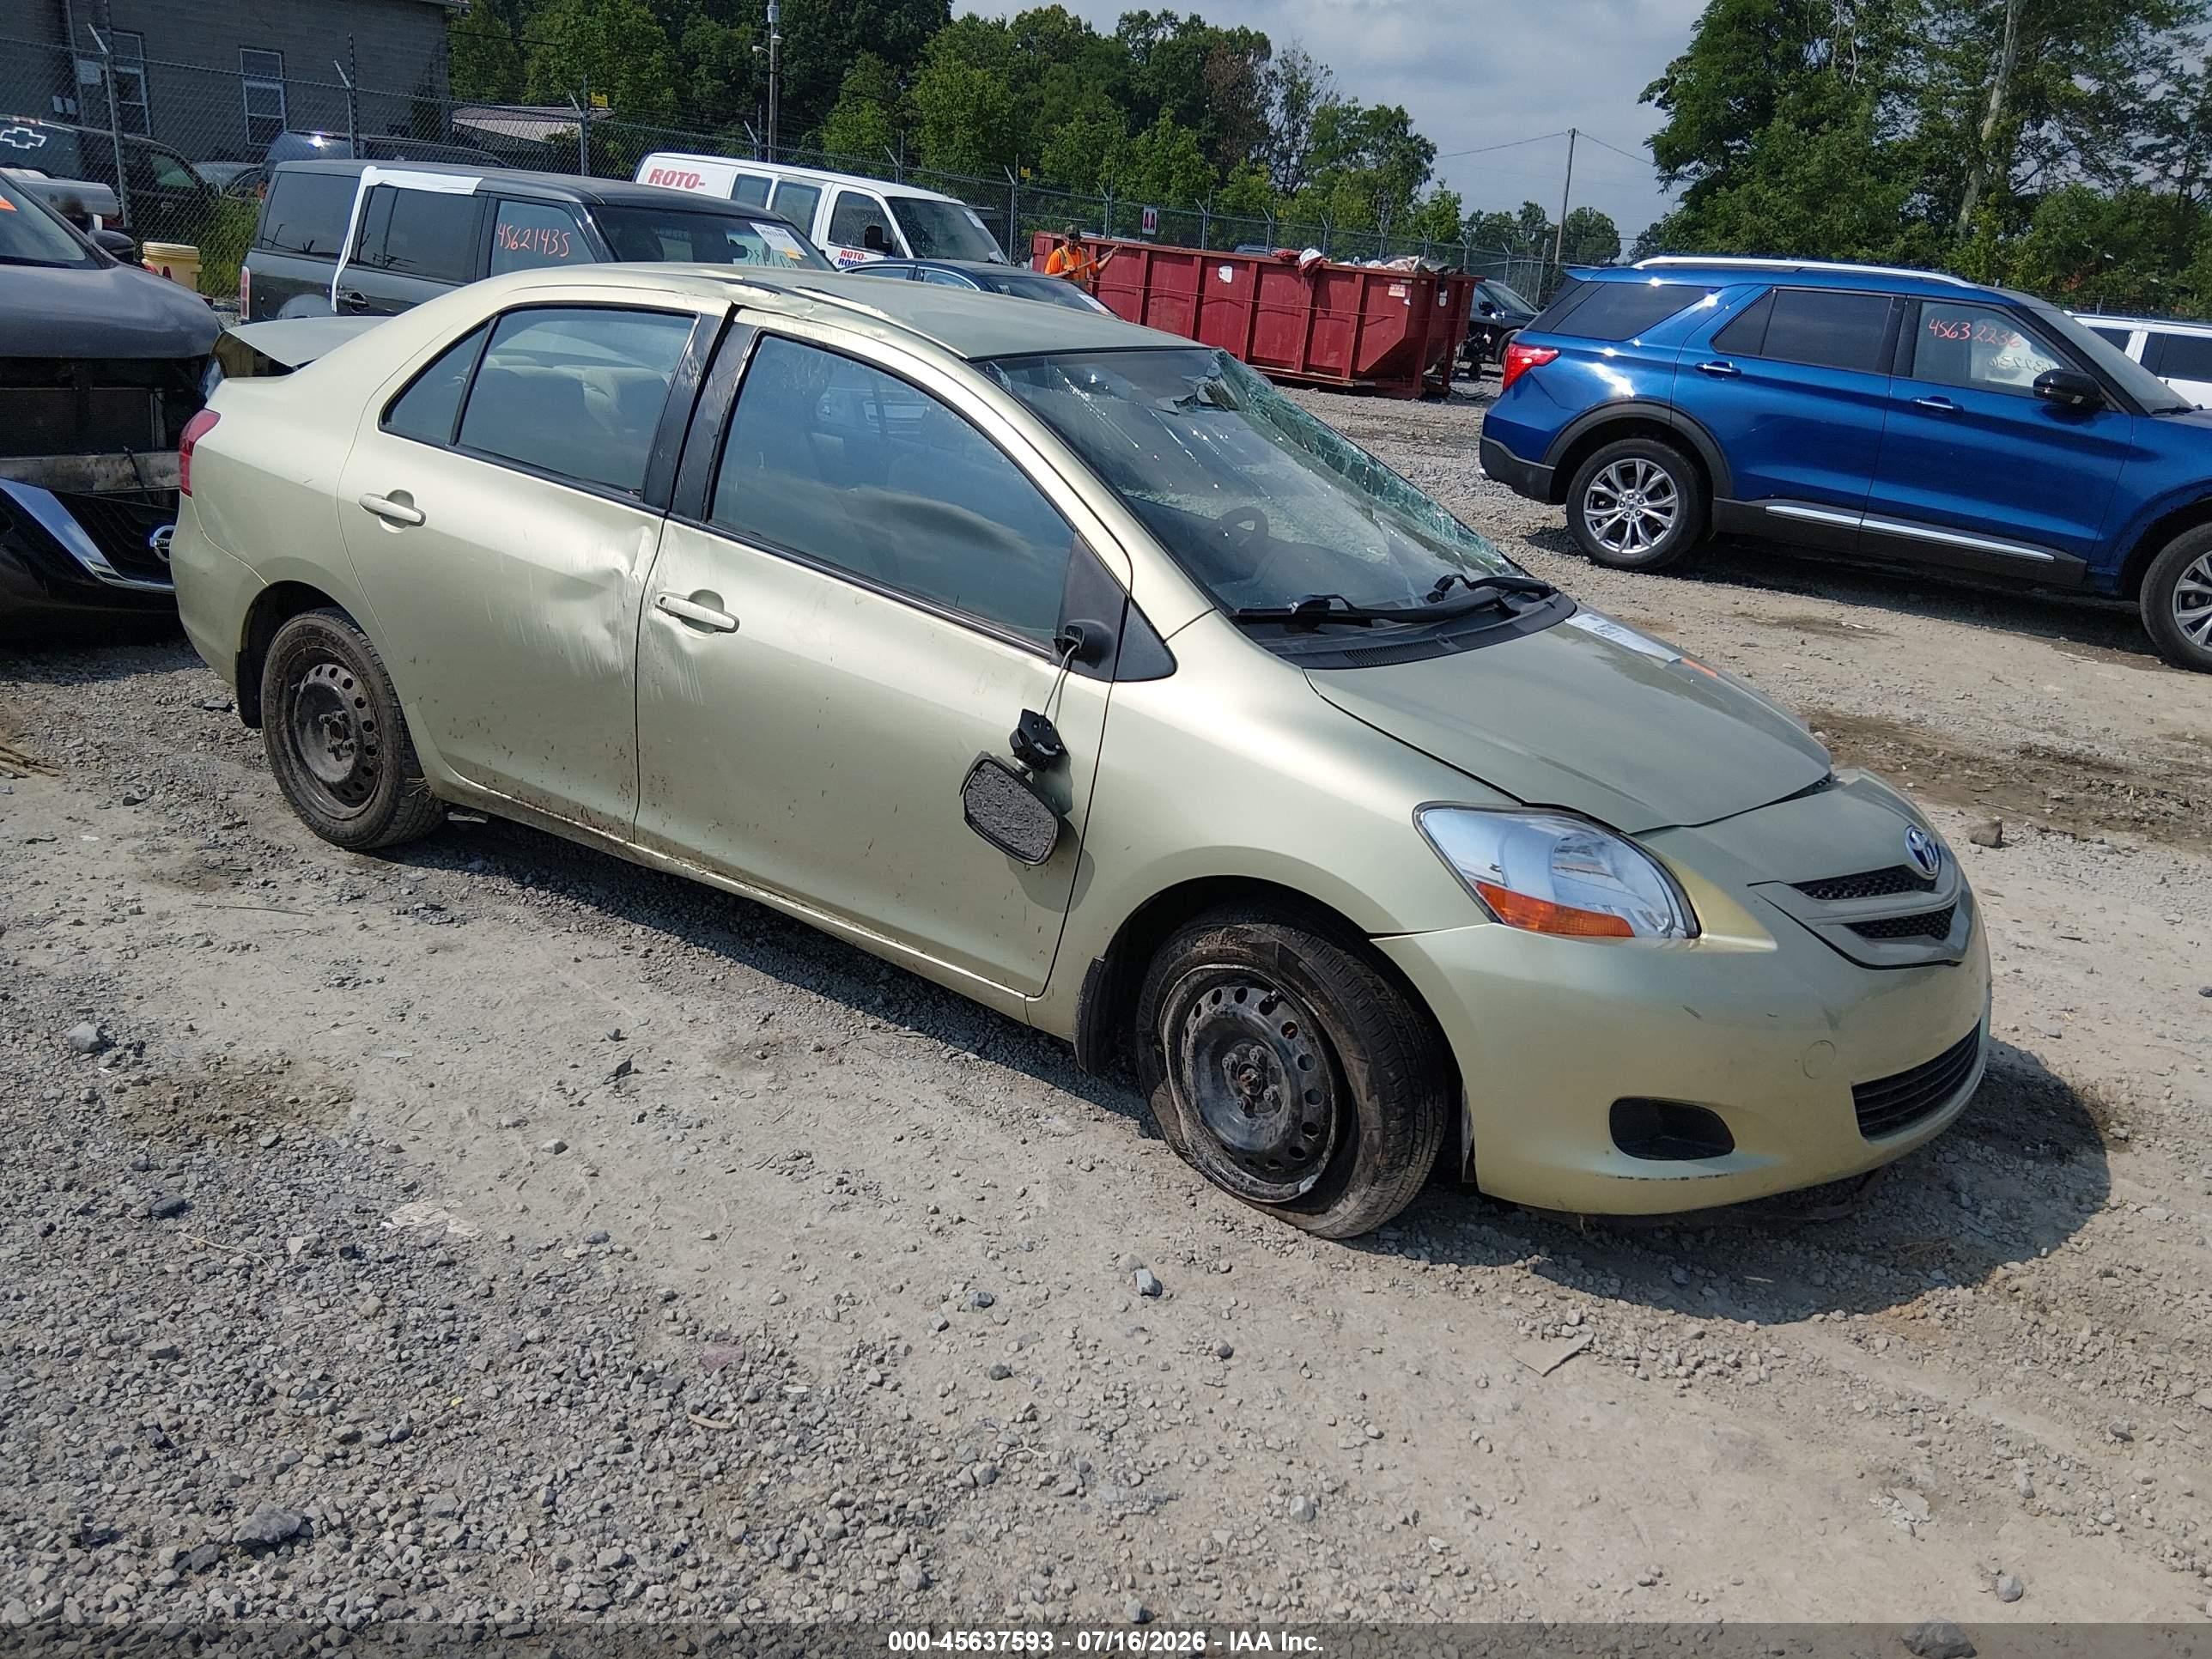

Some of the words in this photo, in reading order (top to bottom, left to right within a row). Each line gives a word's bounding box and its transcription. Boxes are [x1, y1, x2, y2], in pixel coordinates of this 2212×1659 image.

[648, 168, 706, 189] ROTO-
[497, 222, 571, 257] 45621435
[841, 250, 868, 261] ROTO-
[1929, 318, 2022, 349] 45632236
